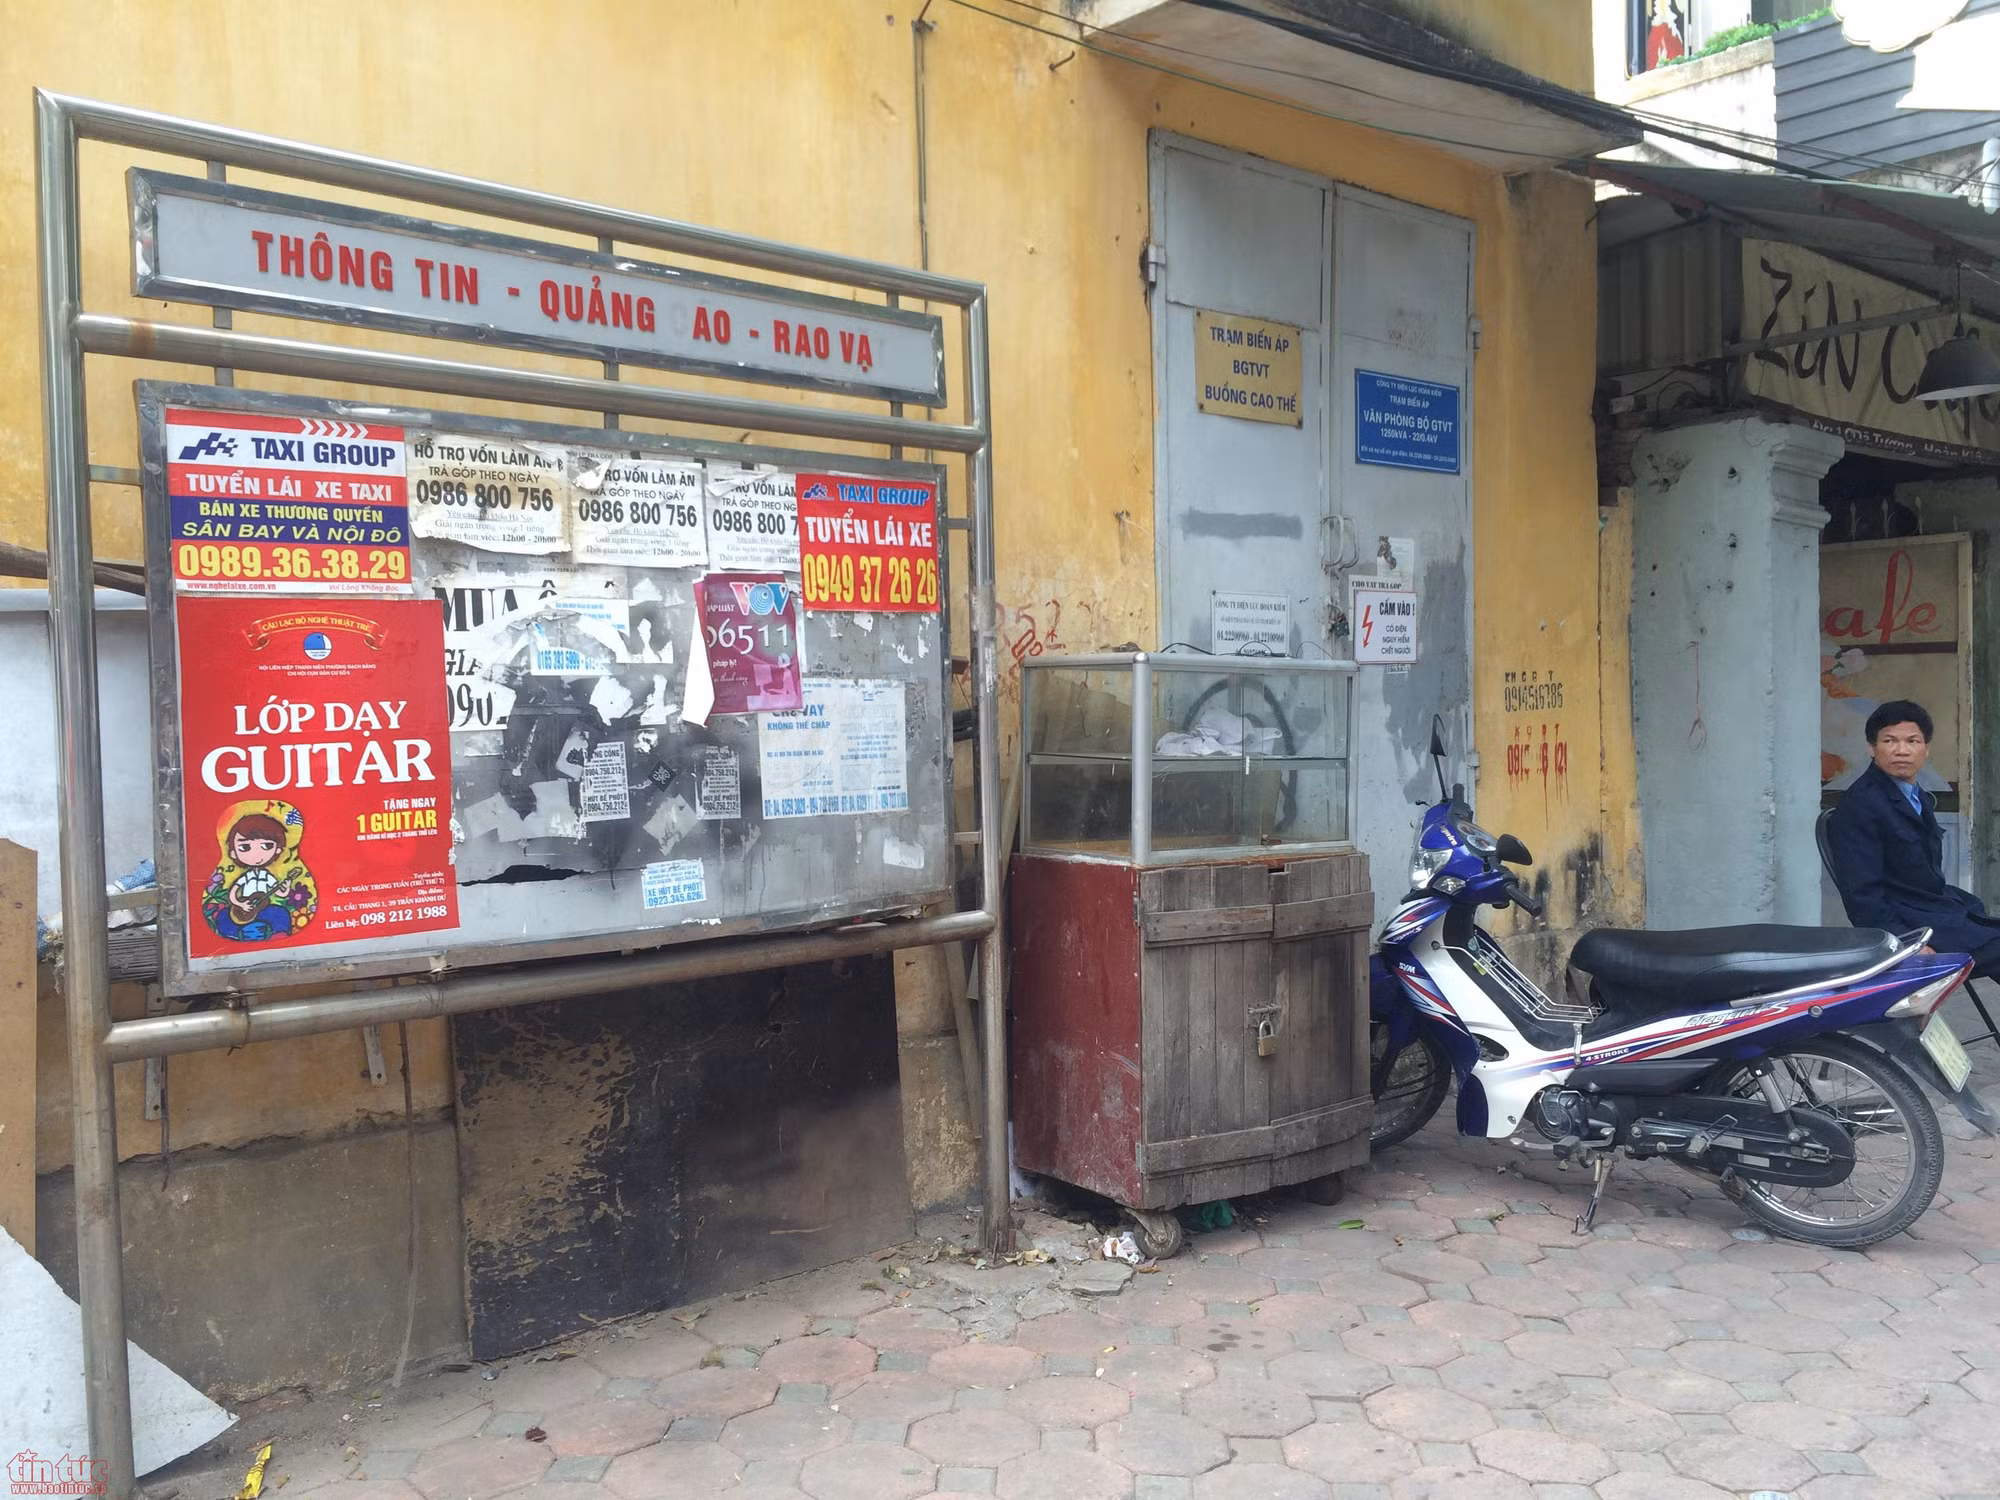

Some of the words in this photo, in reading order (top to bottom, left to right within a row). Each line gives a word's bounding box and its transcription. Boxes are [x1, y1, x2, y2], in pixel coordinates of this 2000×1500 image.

[251, 230, 394, 292] THÔNG
[415, 258, 479, 305] TIN
[540, 275, 656, 333] QUẢNG
[774, 320, 830, 360] RAO
[1210, 326, 1243, 347] TRẠM
[1246, 328, 1272, 350] BIẾN
[1275, 334, 1289, 352] ÁP
[1233, 360, 1270, 379] BGTVT
[1250, 392, 1274, 410] CAO
[1277, 393, 1297, 413] THẾ
[1390, 395, 1406, 408] TRẠM
[1364, 408, 1382, 424] VĂN
[1384, 412, 1415, 428] PHÒNG
[1417, 416, 1430, 432] BỘ
[1432, 420, 1453, 433] GTVT
[251, 437, 304, 462] TAXI
[313, 441, 396, 468] GROUP
[414, 438, 434, 458] HỖ
[438, 446, 465, 466] TRỢ
[469, 444, 498, 464] VỐN
[502, 448, 529, 466] LÀM
[186, 469, 260, 496] TUYỂN
[268, 475, 301, 497] LÁI
[314, 480, 342, 499] XE
[348, 482, 392, 502] TAXI
[429, 464, 449, 477] TRẢ
[452, 464, 476, 479] GÓP
[480, 470, 506, 481] THEO
[510, 469, 540, 484] NGÀY
[624, 466, 648, 484] VỐN
[652, 470, 676, 486] LÀM
[680, 472, 696, 487] ĂN
[416, 480, 468, 506] 0986
[474, 484, 512, 510] 800
[518, 487, 554, 512] 756
[609, 486, 630, 498] GÓP
[634, 490, 656, 499] THEO
[659, 489, 686, 502] NGÀY
[752, 478, 776, 496] VỐN
[837, 483, 874, 504] TAXI
[877, 487, 930, 506] GROUP
[199, 499, 235, 518] BÁN
[239, 503, 260, 518] XE
[265, 504, 328, 521] THƯƠNG
[579, 498, 624, 523] 0986
[630, 502, 660, 525] 800
[666, 504, 697, 528] 756
[722, 496, 738, 507] TRẢ
[740, 497, 759, 508] GÓP
[761, 500, 782, 510] THEO
[182, 519, 231, 538] SÂN
[238, 523, 285, 539] BAY
[292, 524, 320, 541] VÀ
[327, 526, 365, 546] NỘI
[370, 527, 402, 544] ĐÔ
[713, 509, 752, 534] 0986
[758, 512, 786, 535] 800
[804, 508, 869, 544] TUYỂN
[873, 515, 904, 546] LÁI
[909, 522, 932, 547] XE
[178, 544, 406, 580] 0989.36.38.29
[803, 553, 854, 603] 0949
[859, 555, 882, 603] 37
[888, 556, 911, 604] 26
[916, 558, 938, 605] 26
[729, 581, 790, 616] VOV
[1380, 597, 1396, 616] CẤM
[1397, 600, 1411, 616] VÀO
[1823, 550, 1942, 645] afe
[1386, 624, 1394, 632] CÓ
[234, 694, 316, 736] LỚP
[323, 700, 408, 737] DẠY
[201, 738, 436, 794] GUITAR
[384, 798, 409, 812] TẶNG
[411, 797, 436, 808] NGAY
[356, 814, 366, 834] 1
[370, 809, 438, 833] GUITAR
[326, 920, 344, 930] Liên
[360, 912, 386, 925] 098
[389, 909, 413, 922] 212
[417, 906, 448, 919] 1988
[1399, 962, 1416, 974] SYM
[1585, 1047, 1630, 1062] 4-STROKE
